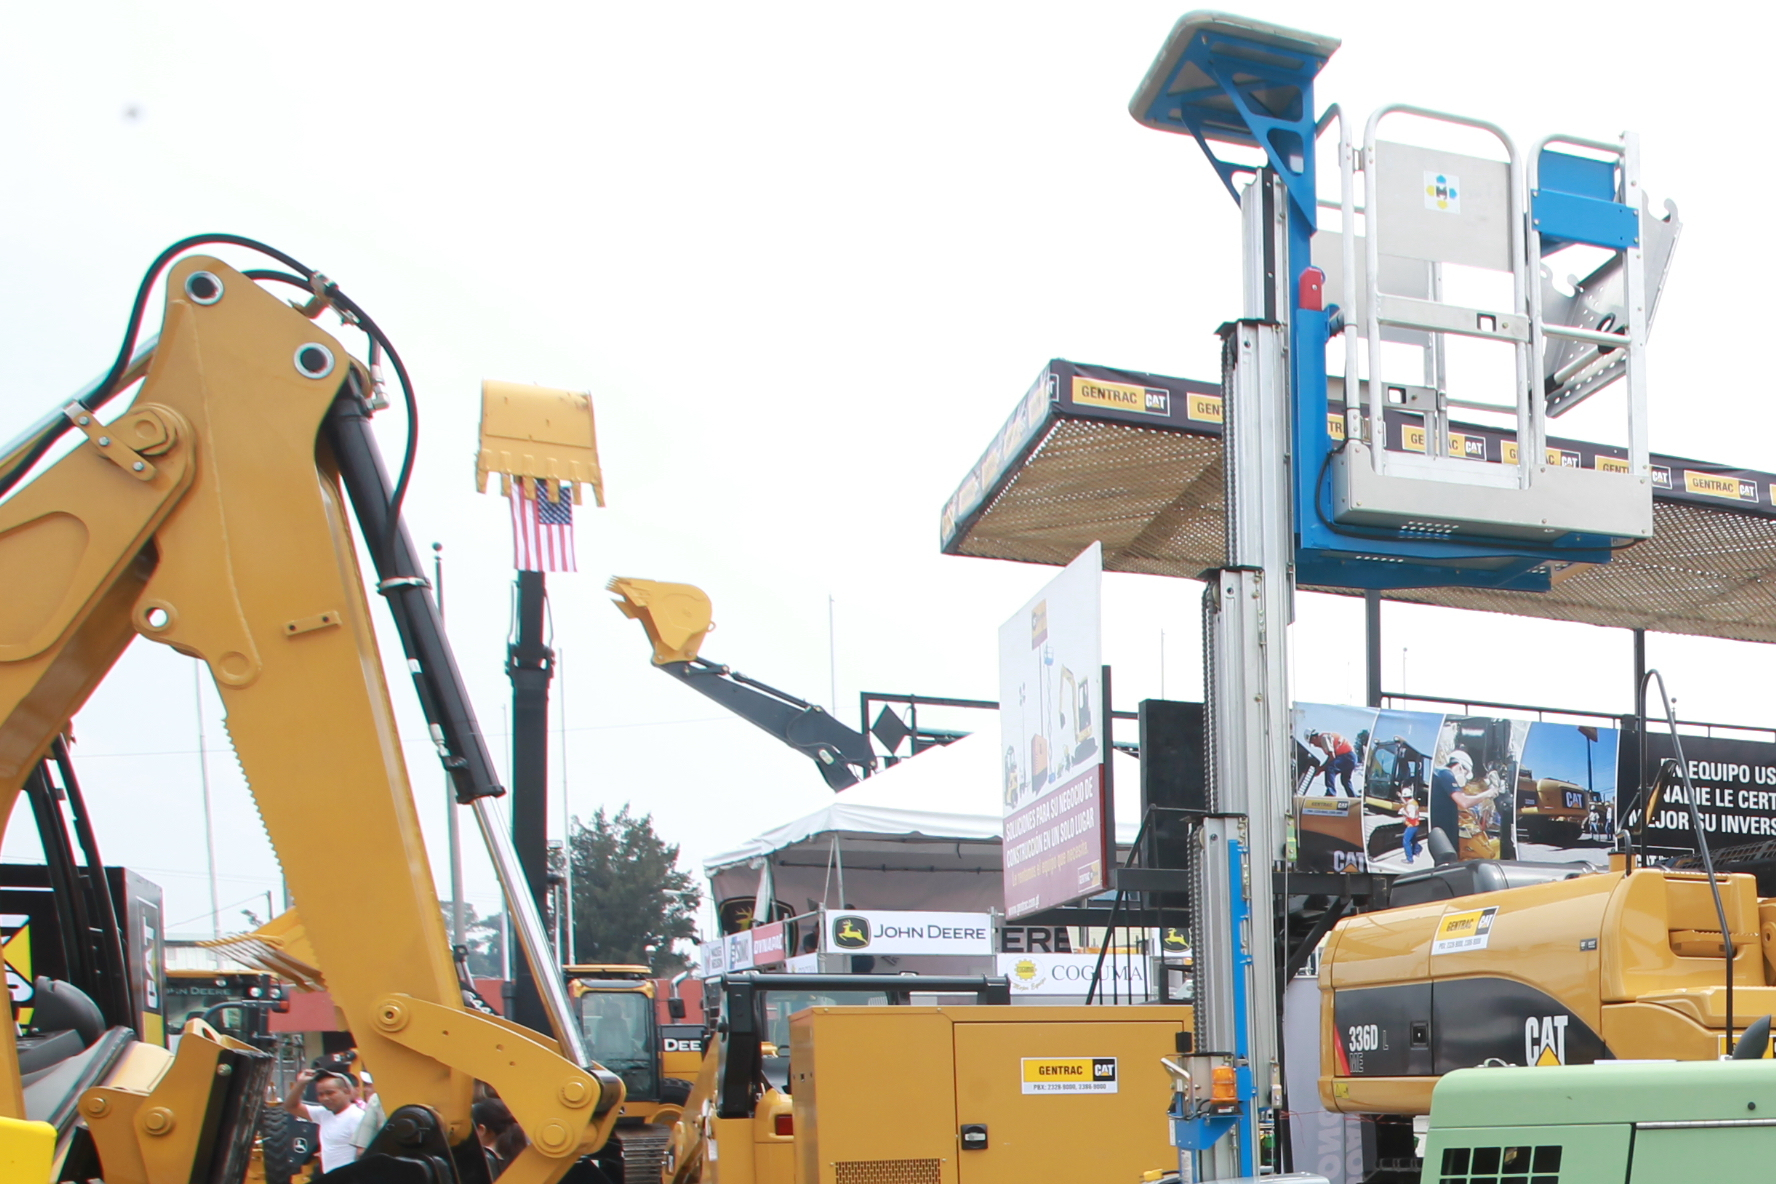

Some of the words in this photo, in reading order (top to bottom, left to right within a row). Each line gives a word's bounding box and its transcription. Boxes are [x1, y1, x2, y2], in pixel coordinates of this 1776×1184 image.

[1081, 385, 1138, 405] GENTRAC
[1145, 393, 1167, 411] CAT
[1465, 439, 1483, 455] CAT
[1652, 471, 1669, 484] CAT
[1692, 477, 1734, 494] GENTRAC
[1739, 484, 1755, 499] CAT
[1688, 760, 1751, 782] EQUIPO
[1565, 791, 1583, 809] CAT
[1715, 788, 1735, 808] LE
[1006, 808, 1036, 843] SOLUCIONES
[1036, 800, 1051, 829] PARA
[1050, 795, 1059, 821] SU
[1059, 781, 1084, 816] NEGOCIO
[1084, 776, 1094, 800] DE
[1043, 829, 1051, 853] EN
[1052, 827, 1060, 848] UN
[1060, 818, 1075, 843] SOLO
[1075, 807, 1095, 836] LUGAR
[1333, 849, 1365, 873] CAT
[873, 923, 925, 939] JOHN
[927, 925, 987, 940] DEERE
[1446, 918, 1475, 932] GENTRAC
[1477, 914, 1494, 930] CAT
[1051, 965, 1143, 982] COGUMA
[664, 1038, 702, 1052] DEE
[1348, 1024, 1379, 1052] 336D
[1525, 1015, 1569, 1067] CAT
[1038, 1065, 1083, 1076] GENTRAC
[1094, 1063, 1116, 1077] CAT
